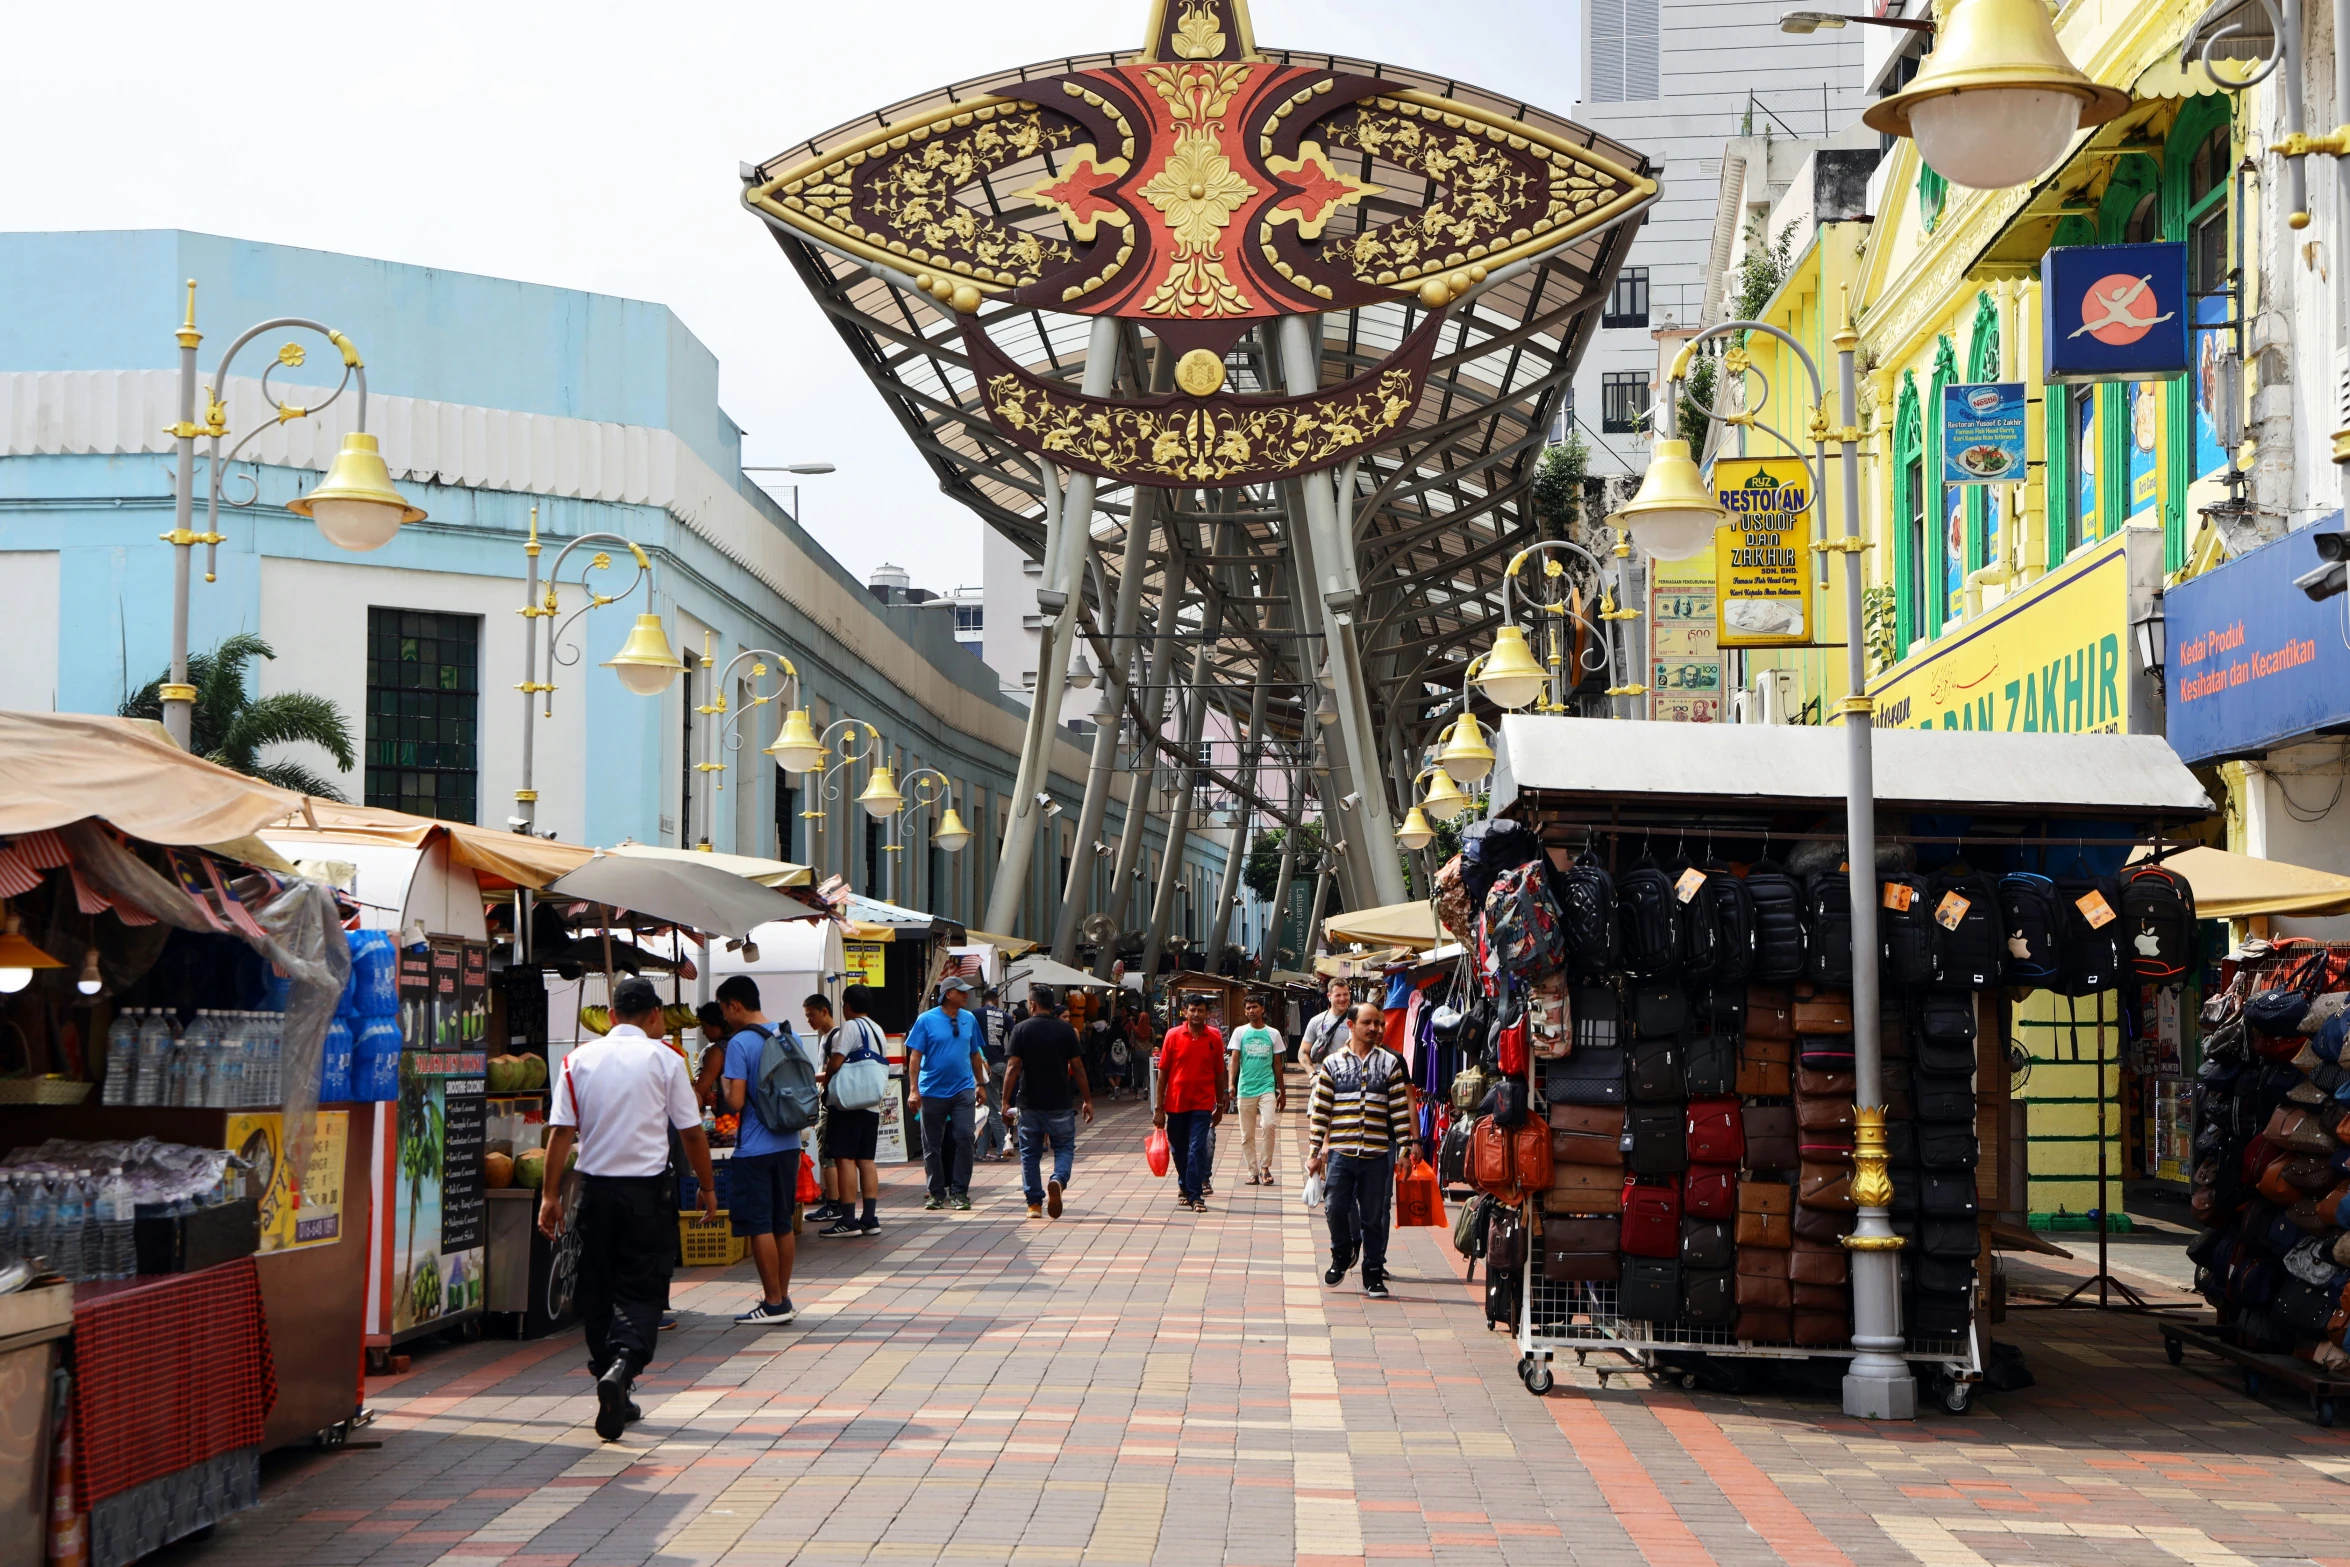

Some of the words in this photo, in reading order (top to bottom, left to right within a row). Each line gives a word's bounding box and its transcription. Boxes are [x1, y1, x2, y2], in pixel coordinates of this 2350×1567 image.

[1976, 419, 1996, 427] Yusoof
[2003, 418, 2022, 426] Zakhir
[1751, 477, 1771, 487] RYZ
[1746, 532, 1780, 546] DAN
[1731, 547, 1796, 567] ZAKHIR
[1782, 576, 1797, 585] Curry
[2180, 633, 2206, 668] Kedai
[2208, 619, 2245, 657] Produk
[1702, 665, 1718, 673] 100
[2180, 668, 2227, 703] Kesihatan
[2229, 659, 2249, 687] dan
[2251, 638, 2316, 680] Kecantikan
[2005, 633, 2119, 733] ZAKHIR
[1296, 888, 1304, 919] Laluan
[1296, 921, 1304, 955] Kasturi
[433, 949, 458, 969] Coconut
[468, 949, 483, 967] Fresh
[464, 968, 485, 987] Coconut
[466, 1080, 485, 1093] COCONUT
